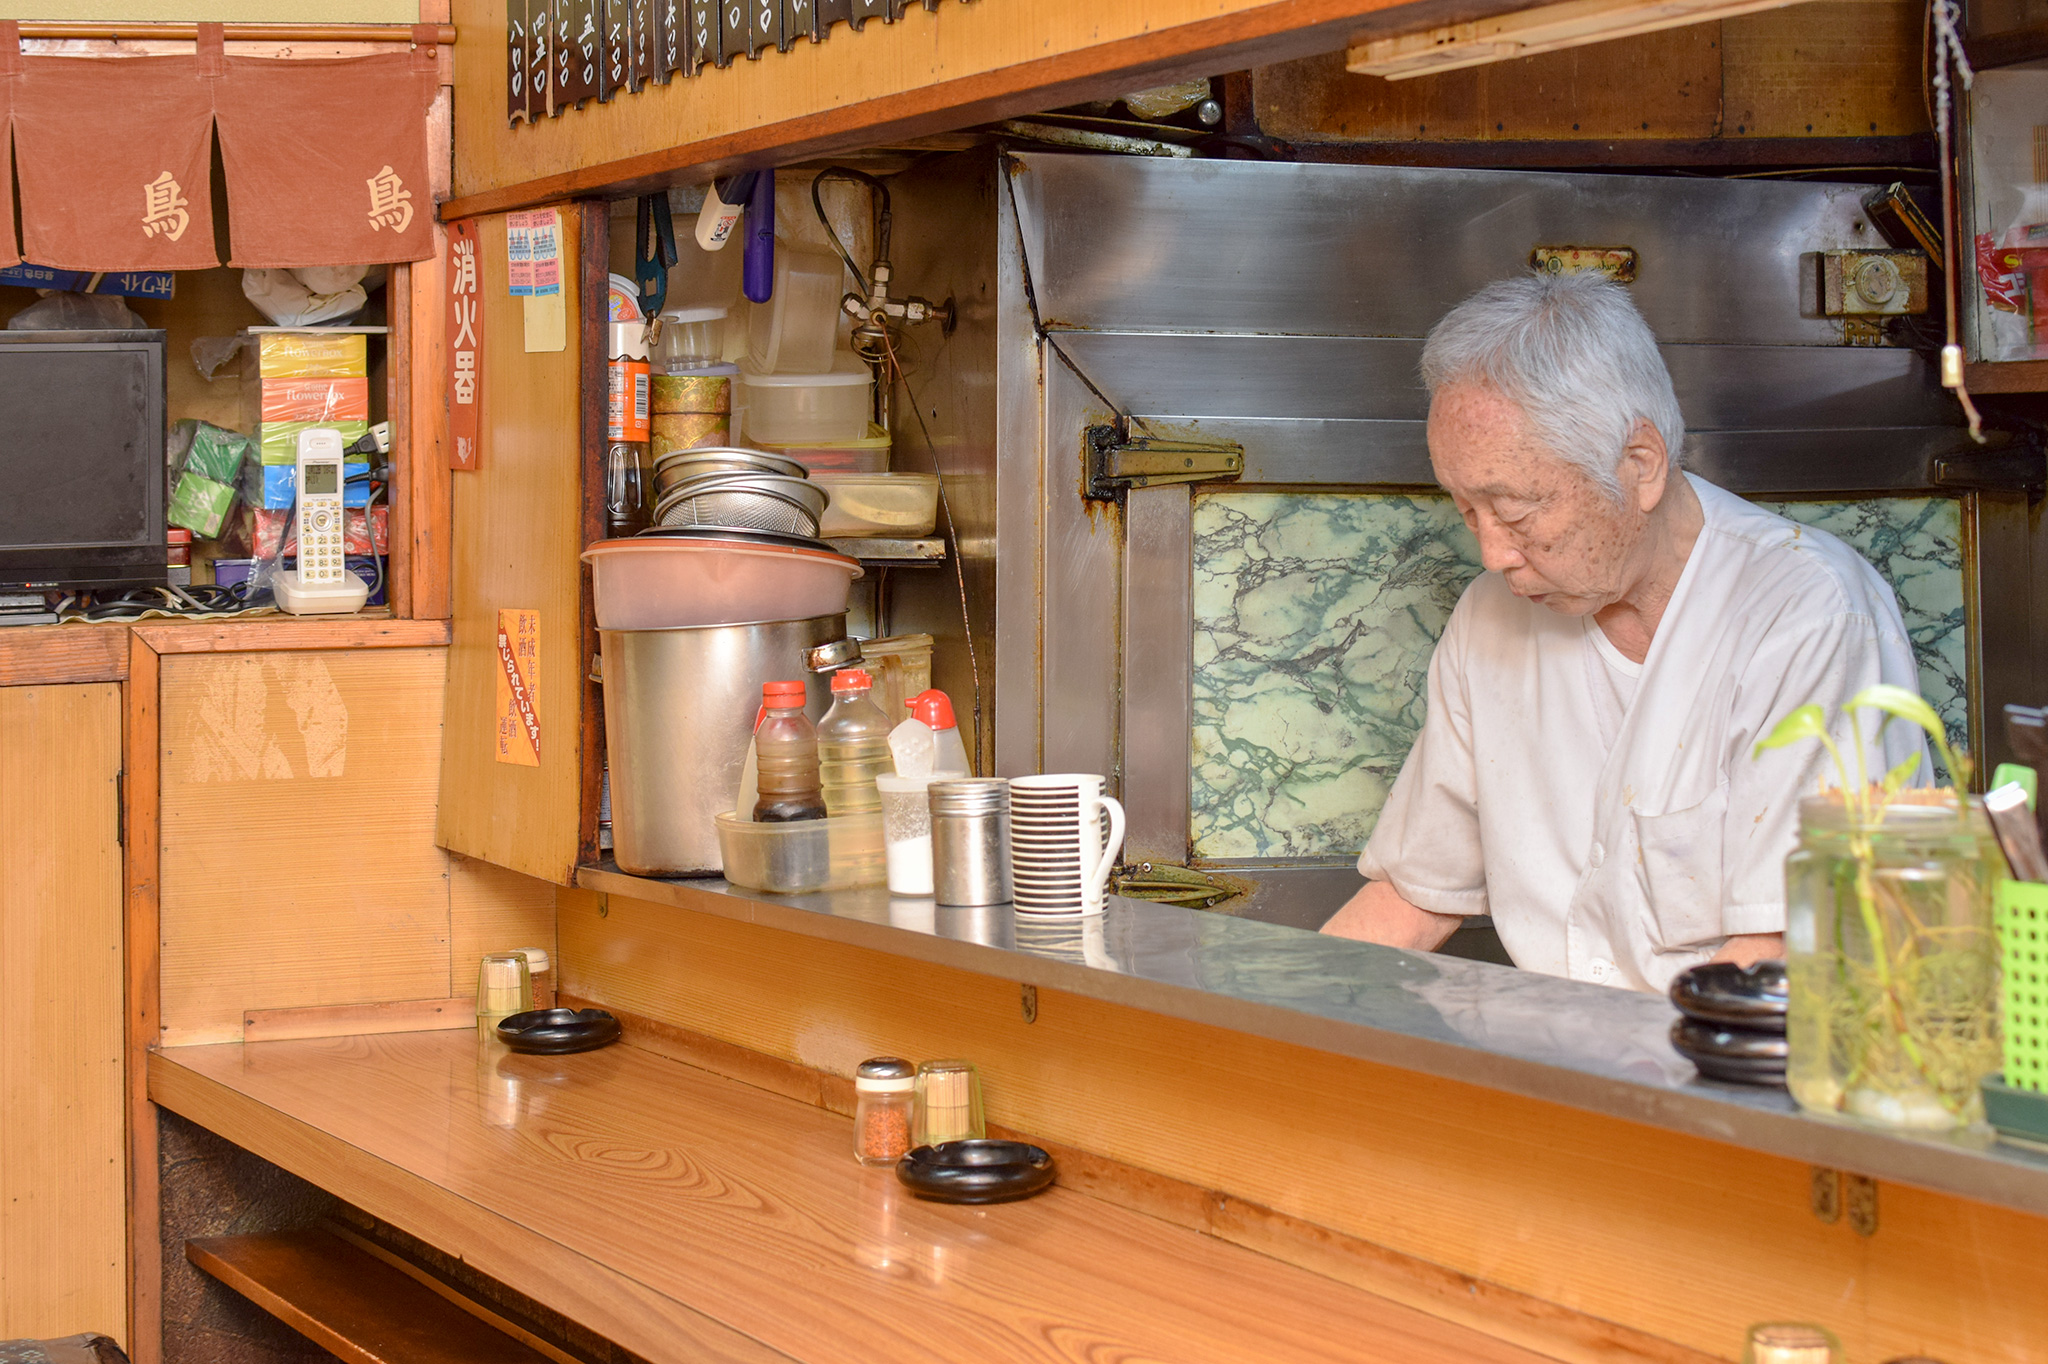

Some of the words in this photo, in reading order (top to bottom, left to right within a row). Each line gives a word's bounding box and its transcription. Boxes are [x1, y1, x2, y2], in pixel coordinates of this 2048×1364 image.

[142, 170, 190, 242] 鳥
[366, 164, 414, 234] 鳥
[120, 273, 172, 294] ホワイト
[453, 239, 477, 405] 消火器
[527, 614, 537, 705] 未成年者
